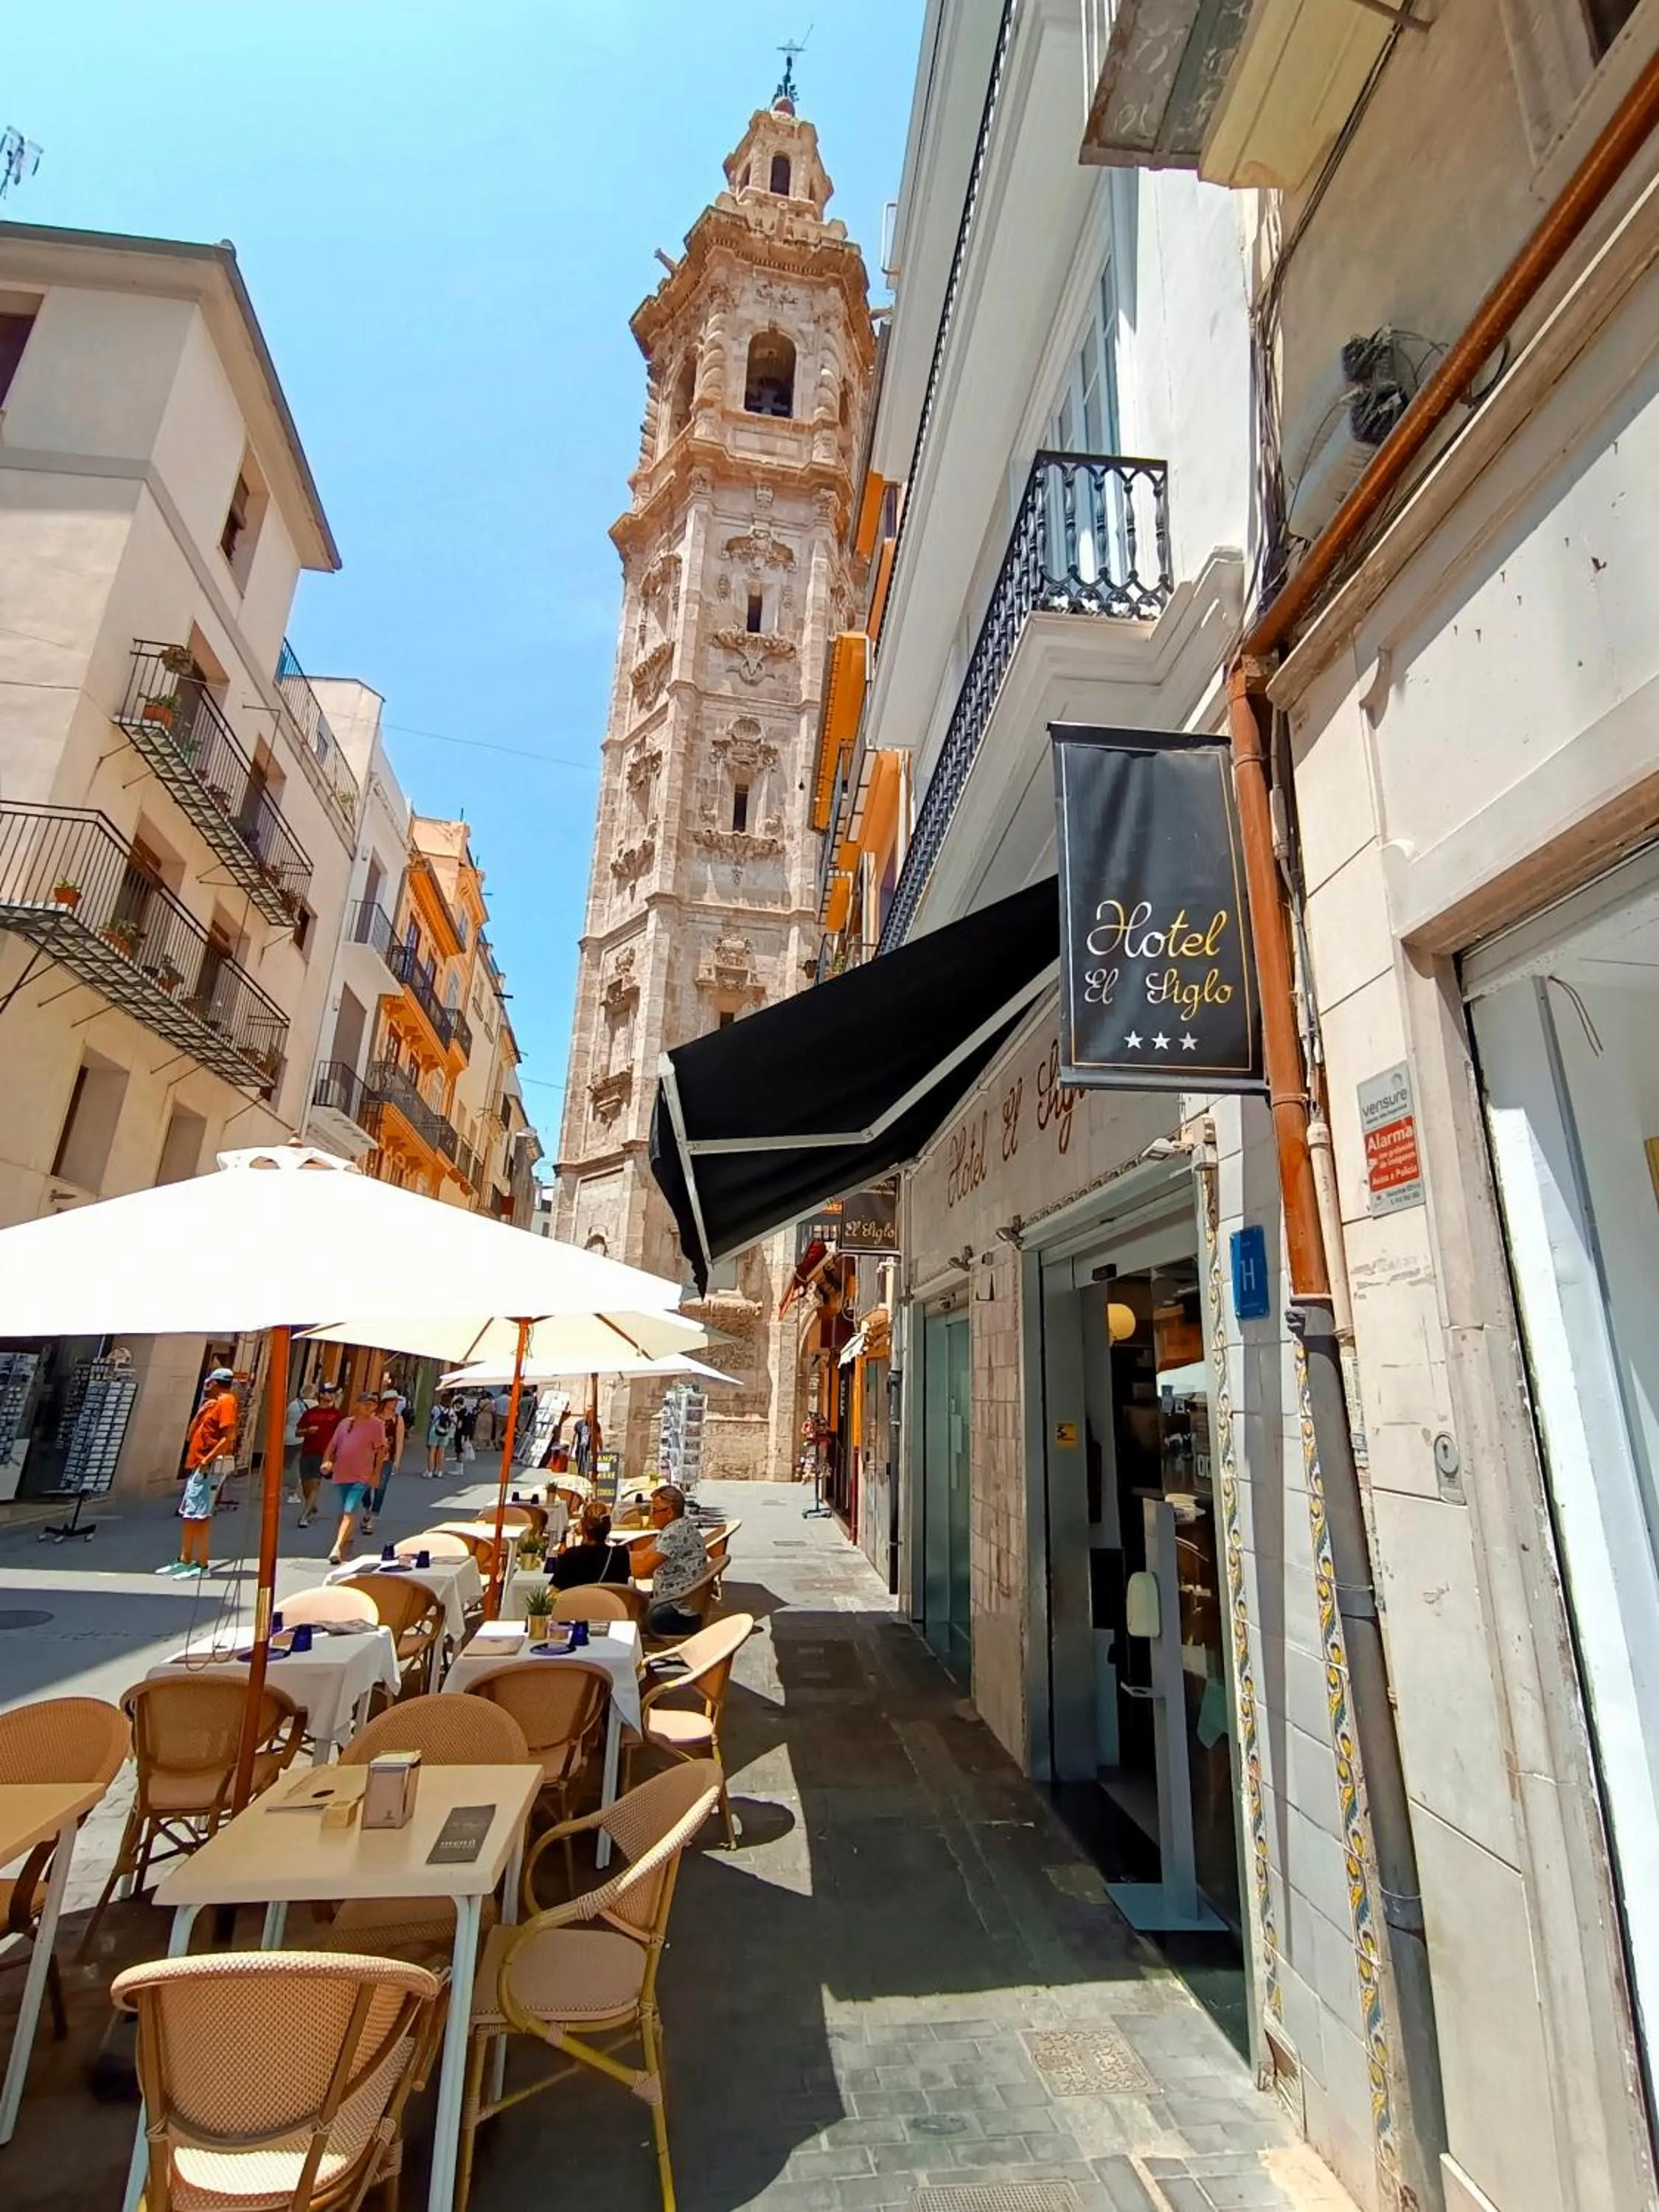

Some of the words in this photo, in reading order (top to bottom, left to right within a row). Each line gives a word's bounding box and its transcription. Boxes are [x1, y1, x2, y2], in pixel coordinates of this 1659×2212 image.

[1086, 900, 1228, 958] Hotel
[1084, 968, 1119, 1004] El
[1145, 968, 1234, 1021] Siglo
[947, 1110, 987, 1208] Hotel
[1002, 1077, 1023, 1162] El
[1037, 1038, 1086, 1155] Sig
[1367, 1124, 1413, 1152] Alarma
[862, 1220, 894, 1245] Siglo
[1240, 1257, 1256, 1293] H
